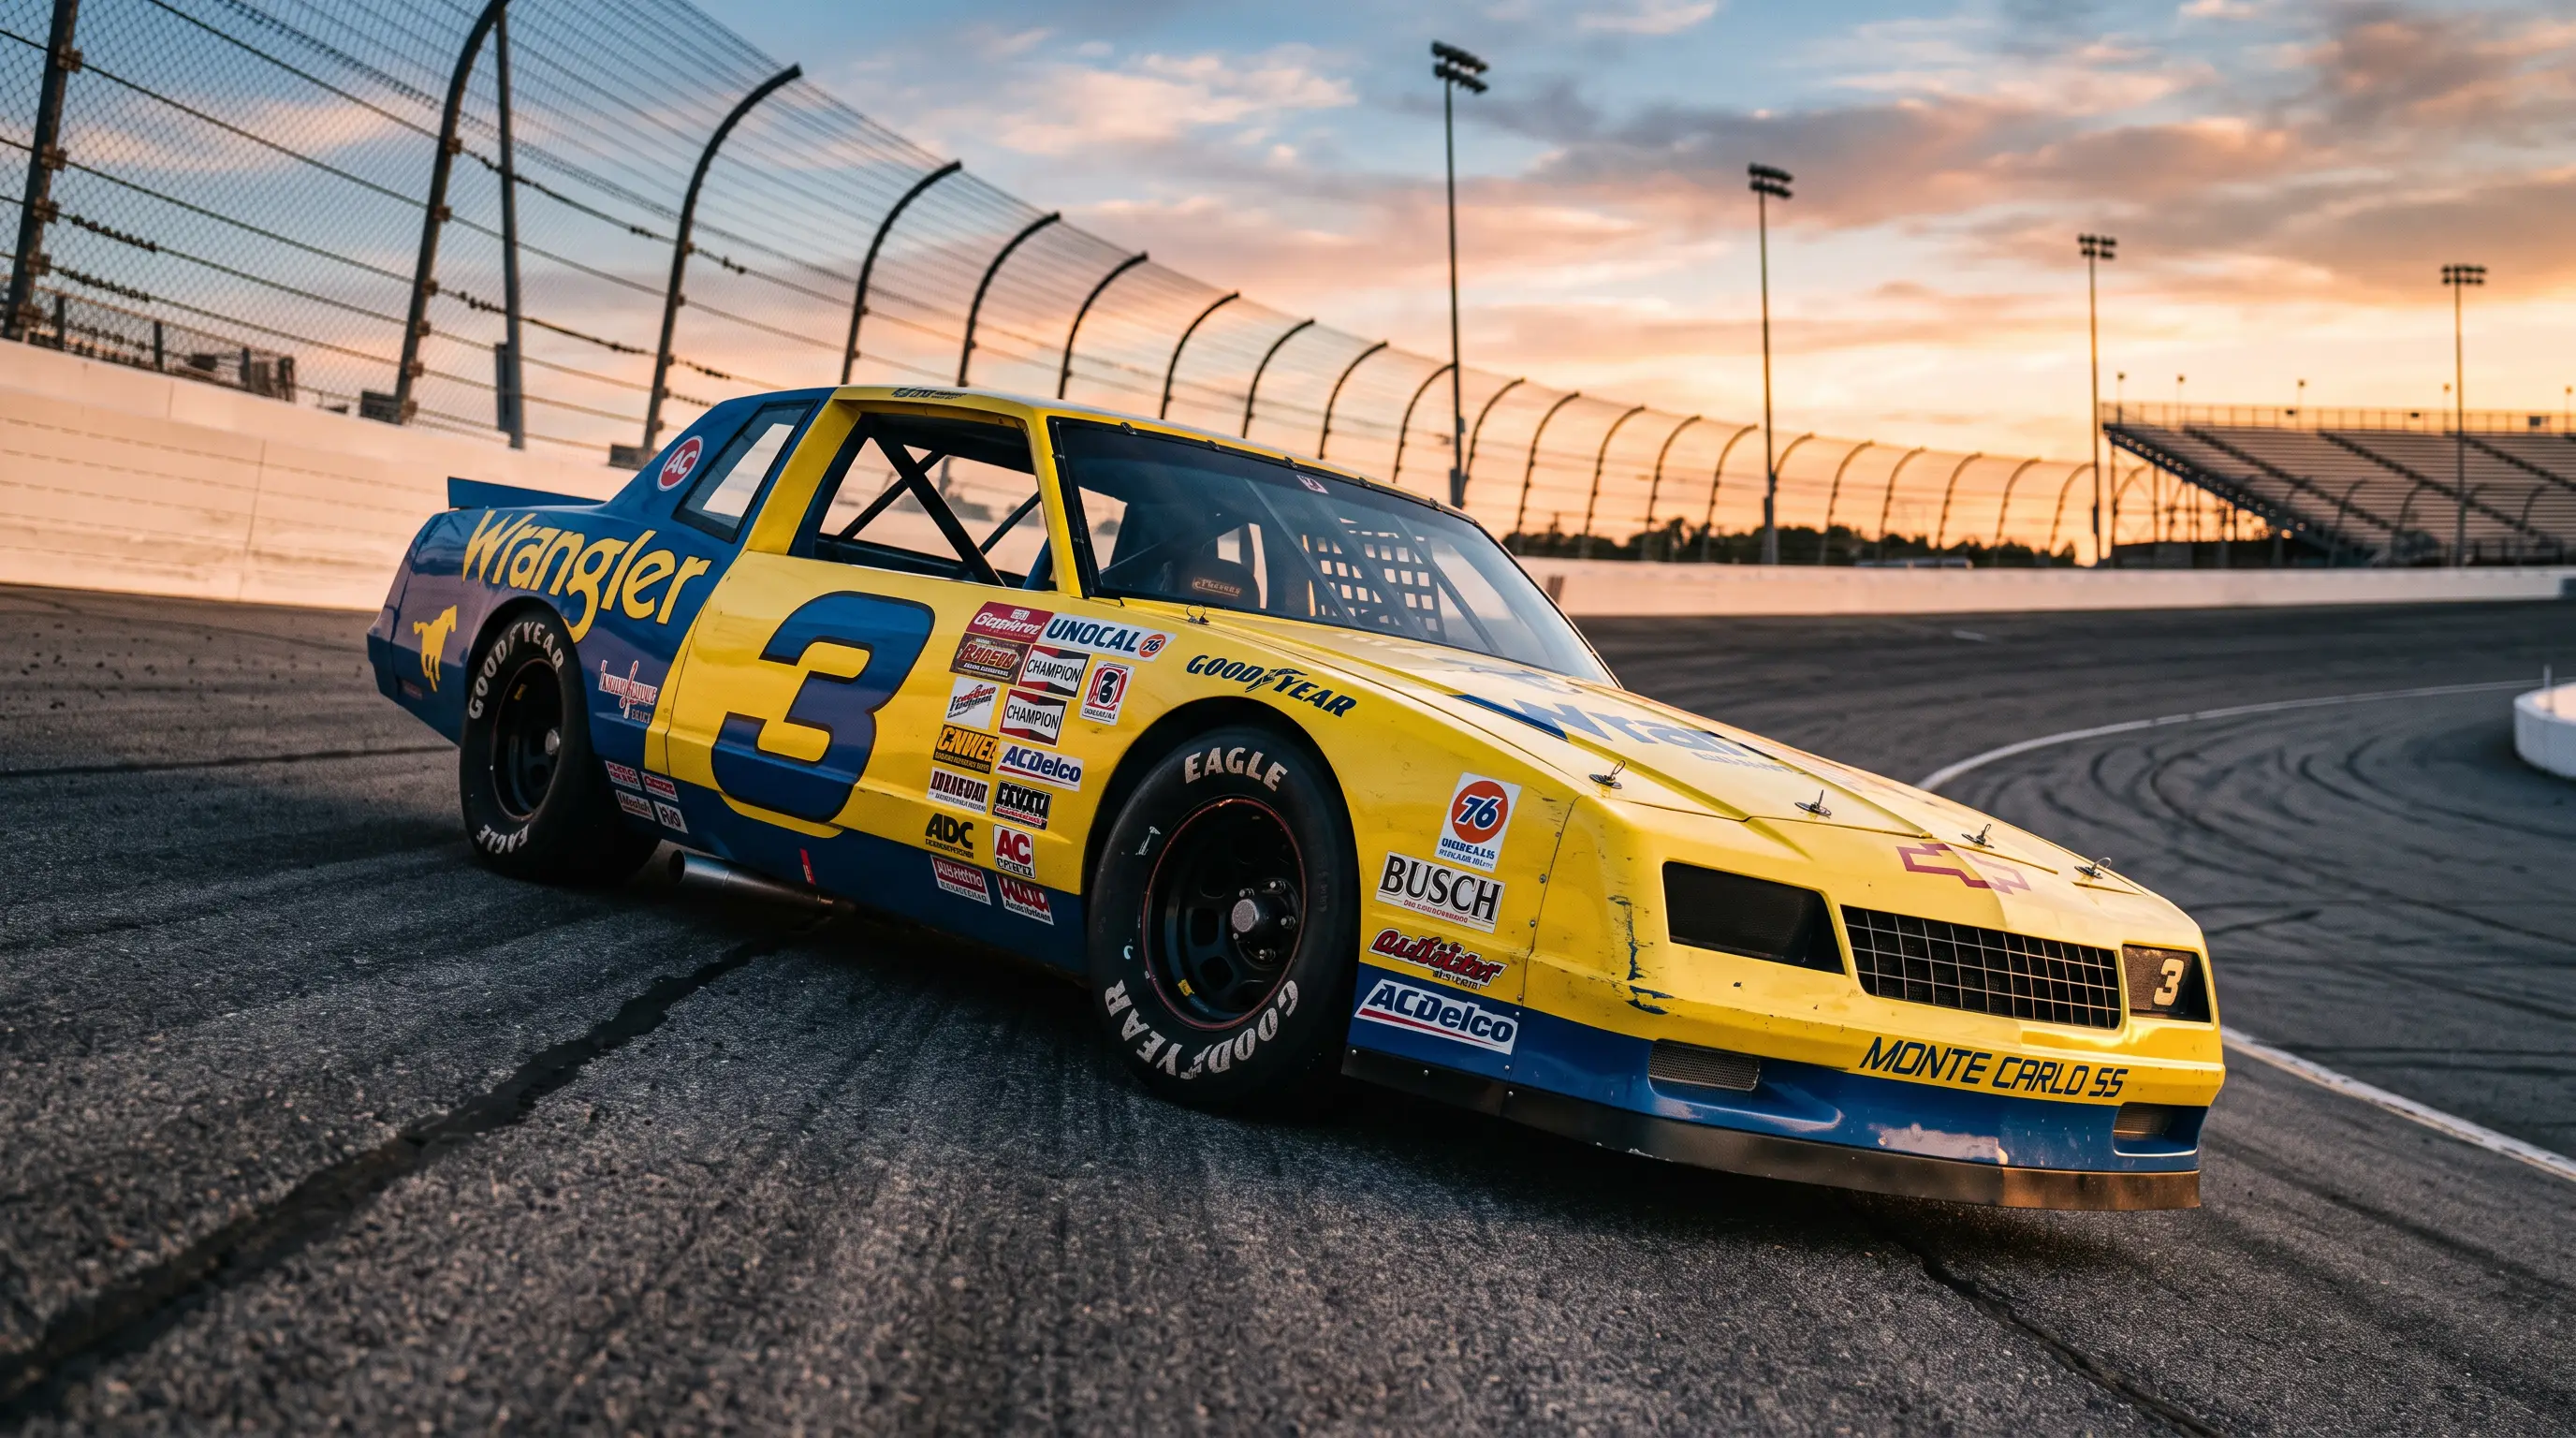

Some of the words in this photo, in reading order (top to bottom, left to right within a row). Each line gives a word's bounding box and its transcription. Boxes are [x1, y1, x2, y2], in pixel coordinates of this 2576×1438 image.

[665, 448, 697, 476] AC
[462, 509, 712, 644] Wrangler
[1046, 618, 1141, 653] UNOCAL
[1026, 658, 1081, 683] CHAMPION
[1186, 654, 1357, 718] GOODYEAR
[710, 590, 936, 823] 3
[1006, 704, 1060, 730] CHAMPION
[1001, 745, 1082, 783] ACDelco
[1184, 747, 1288, 792] EAGLE
[925, 813, 973, 850] ADC
[1456, 796, 1502, 829] 76
[476, 823, 530, 855] EAGLE
[996, 829, 1032, 865] AC
[1379, 855, 1502, 924] BUSCH
[2153, 958, 2185, 1006] 3
[1105, 978, 1299, 1080] GOODYEAR
[1367, 982, 1514, 1043] ACDelco
[1859, 1035, 1992, 1084] MONTE
[1991, 1056, 2090, 1095] CARLO
[2088, 1068, 2130, 1097] SS
